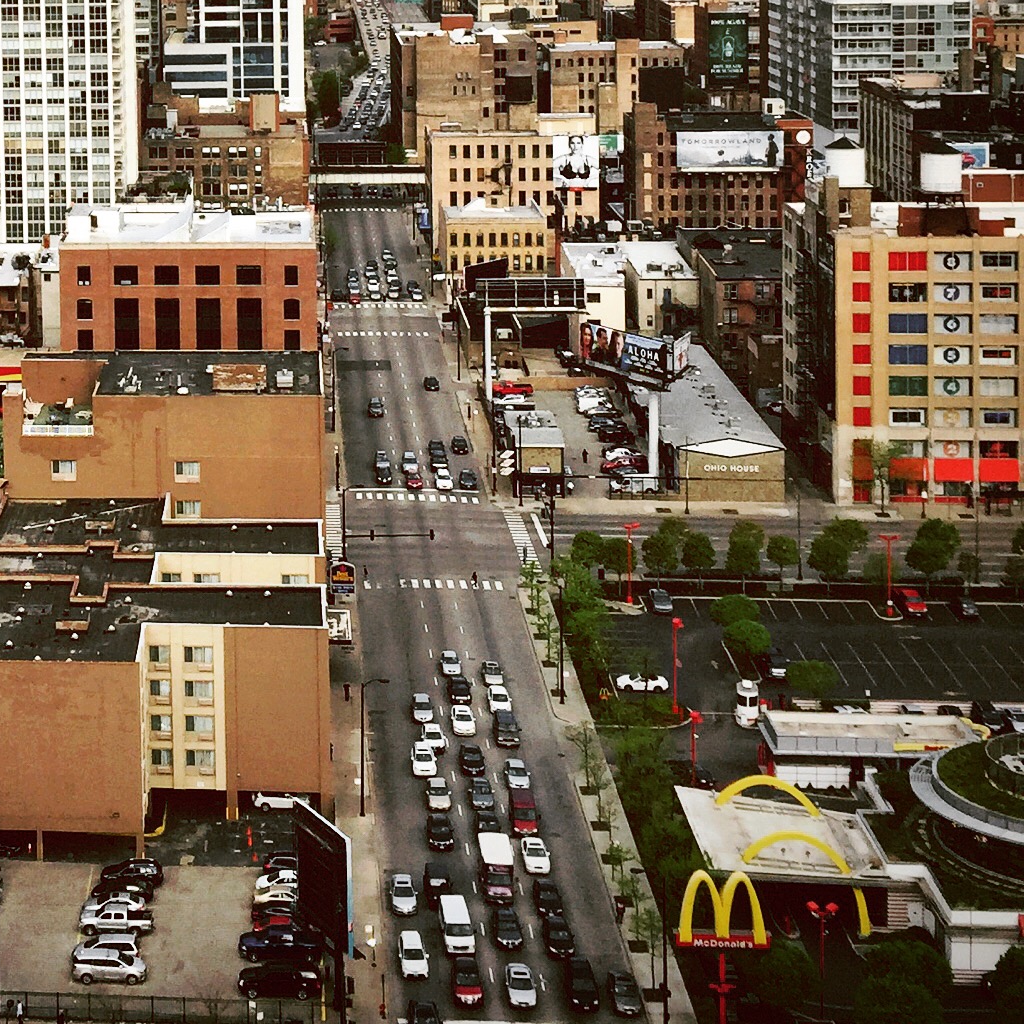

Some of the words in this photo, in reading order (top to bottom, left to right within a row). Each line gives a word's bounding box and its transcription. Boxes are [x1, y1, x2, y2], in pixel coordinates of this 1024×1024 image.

[627, 344, 660, 362] ALOHA
[703, 464, 728, 472] OHIO
[730, 465, 760, 473] HOUSE
[693, 938, 754, 949] McDonald's
